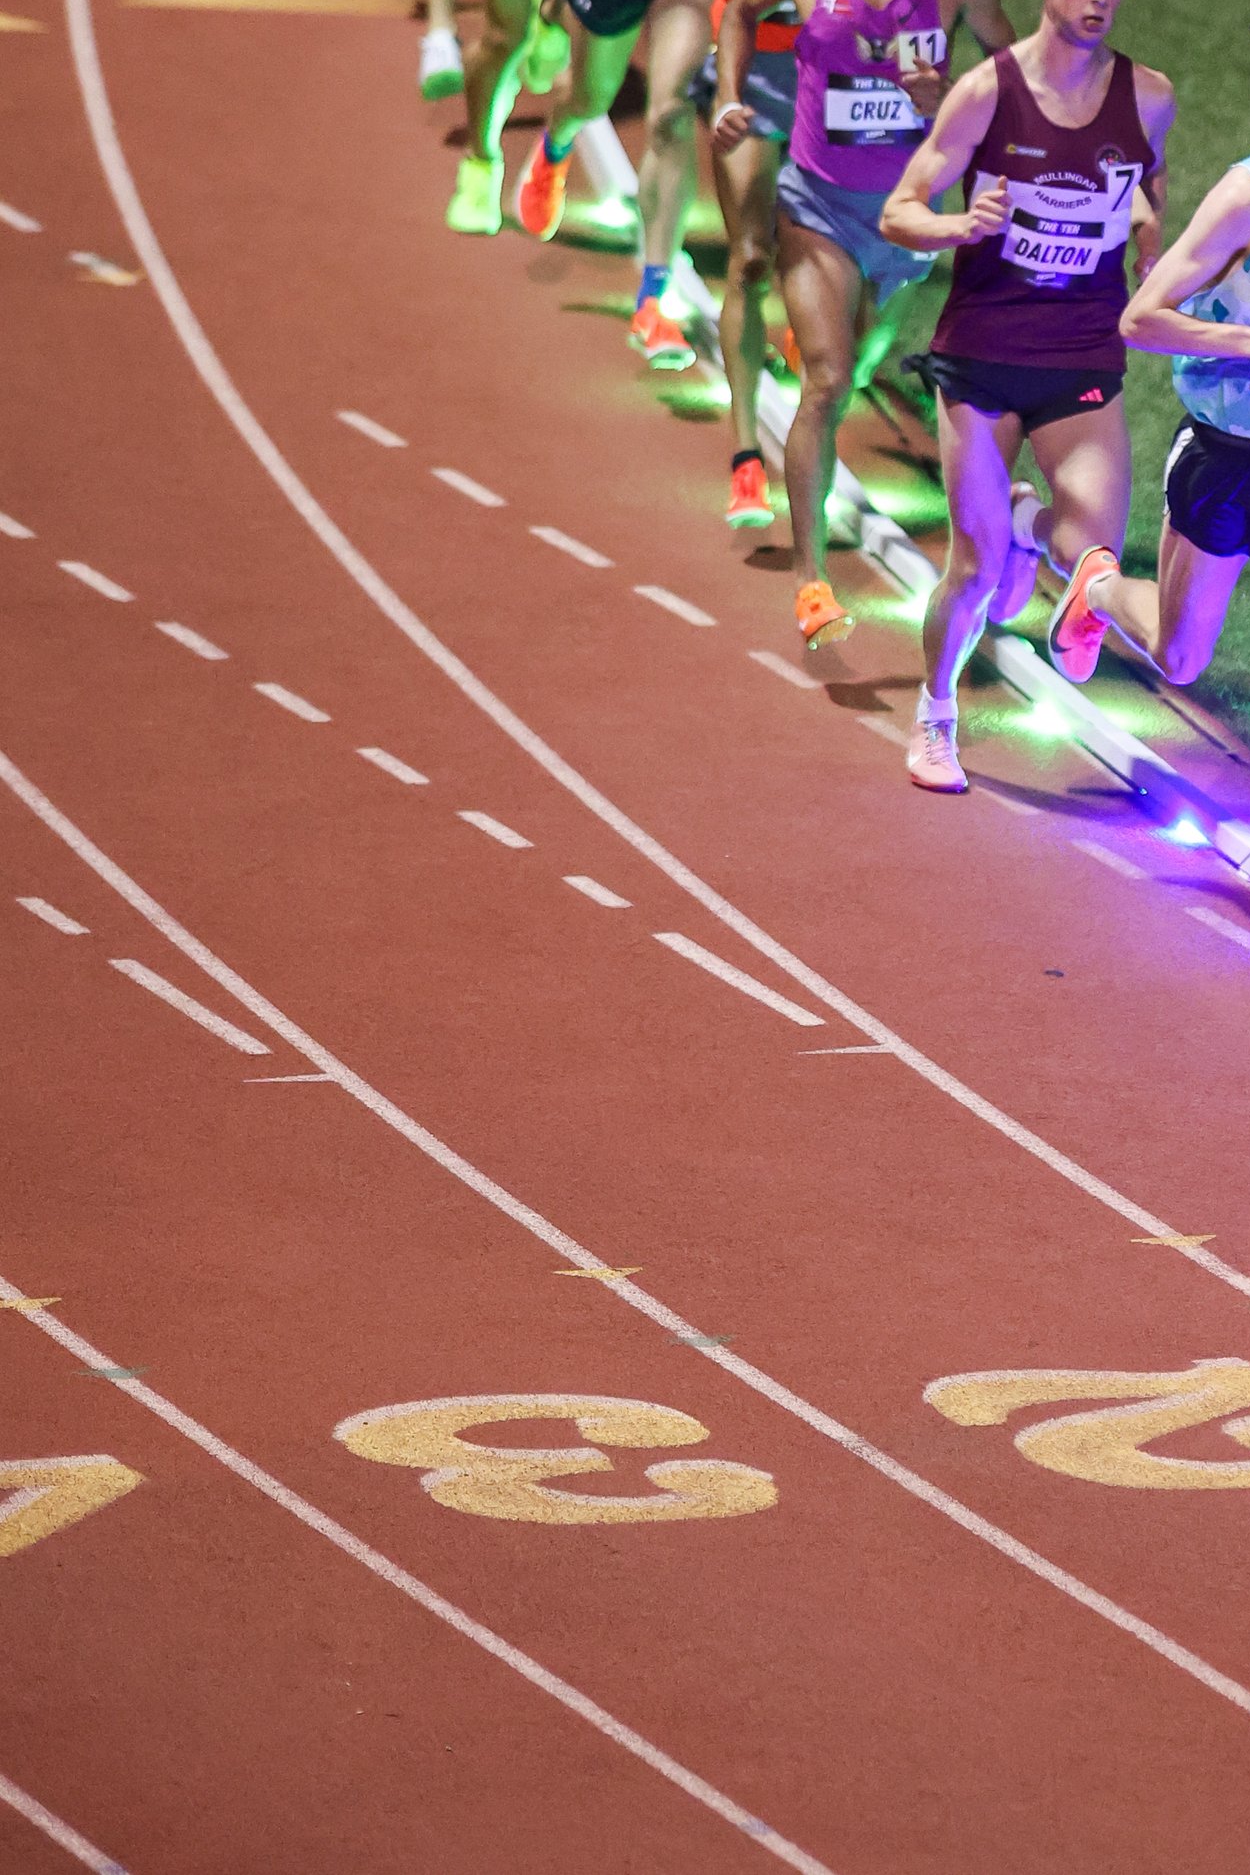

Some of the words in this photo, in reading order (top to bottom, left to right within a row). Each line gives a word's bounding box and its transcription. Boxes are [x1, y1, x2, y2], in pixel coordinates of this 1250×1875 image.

[908, 32, 938, 64] 11
[851, 100, 901, 121] CRUZ
[1033, 171, 1098, 192] MULLINGAR
[1110, 169, 1136, 212] 7
[1034, 190, 1093, 210] HARRIERS
[1014, 237, 1093, 267] DALTON
[333, 1393, 780, 1525] 3
